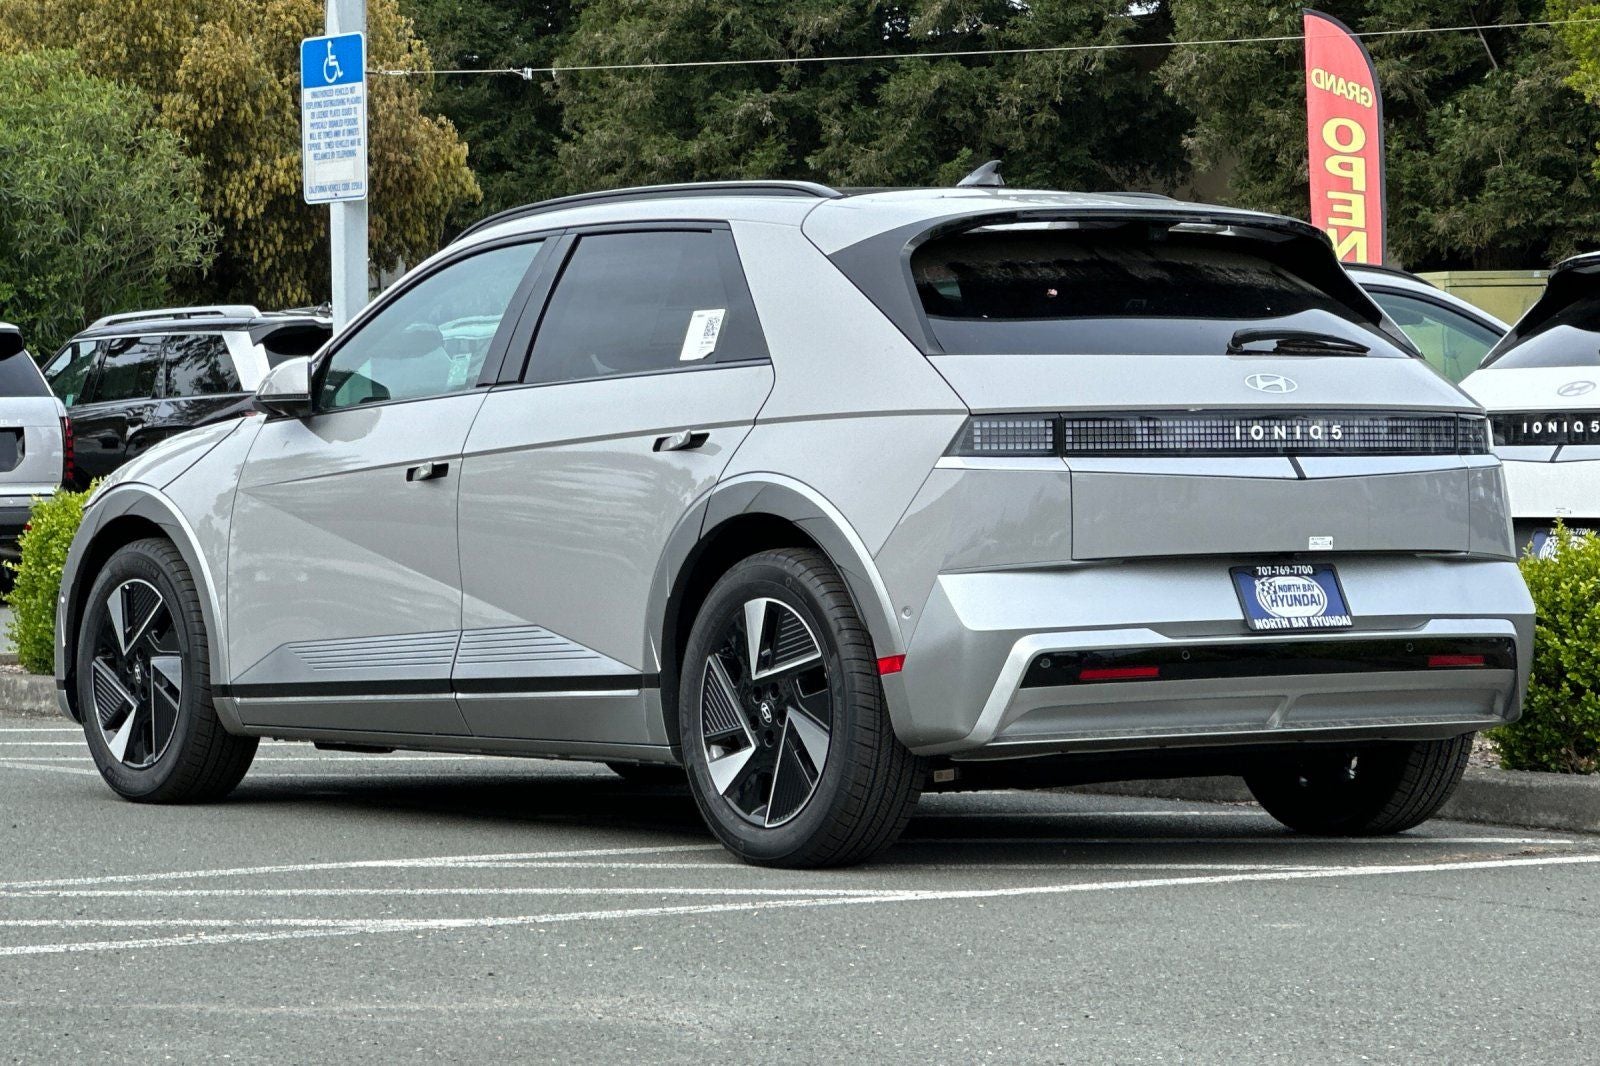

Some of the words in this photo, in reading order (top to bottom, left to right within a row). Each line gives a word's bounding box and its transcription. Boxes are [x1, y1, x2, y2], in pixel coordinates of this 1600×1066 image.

[1256, 565, 1313, 576] 707-769-7700
[1278, 584, 1301, 593] NORTH
[1302, 583, 1315, 592] BAY
[1271, 594, 1321, 608] HYUNDAI
[1254, 618, 1288, 630] NORTH
[1292, 617, 1308, 628] BAY
[1311, 615, 1352, 627] HYUNDAI
